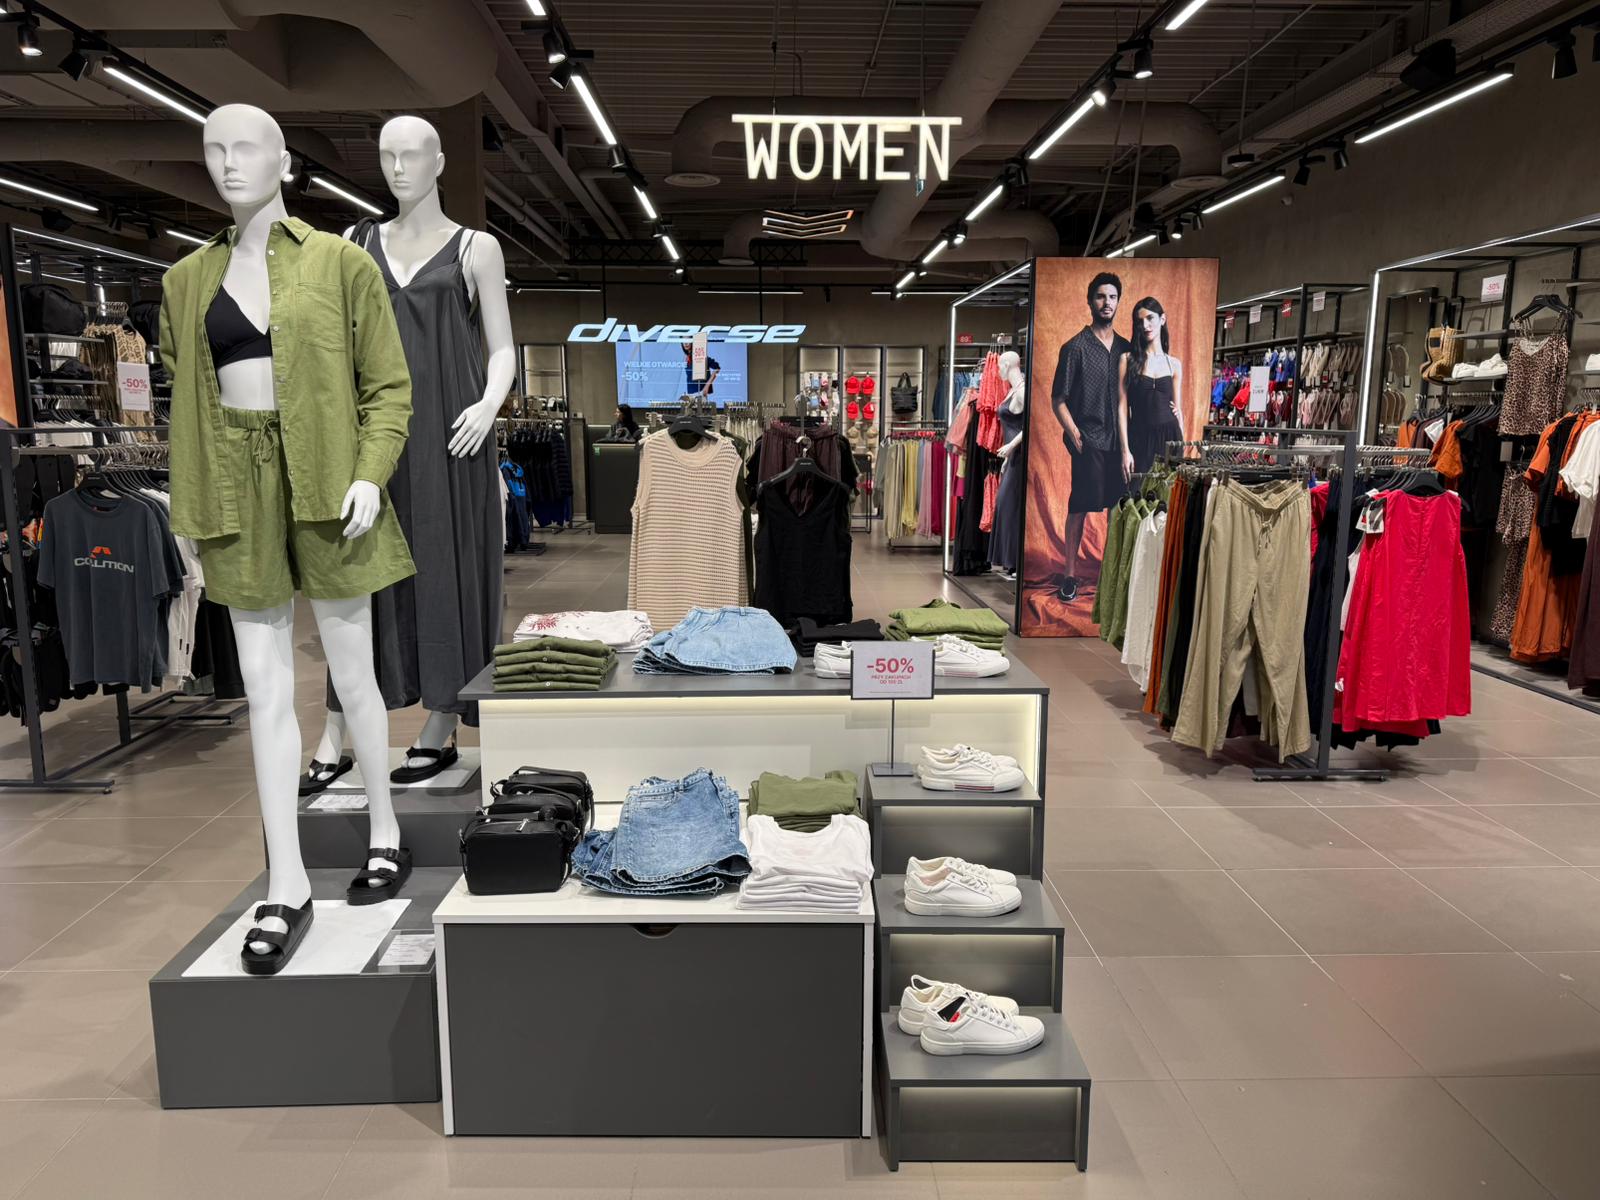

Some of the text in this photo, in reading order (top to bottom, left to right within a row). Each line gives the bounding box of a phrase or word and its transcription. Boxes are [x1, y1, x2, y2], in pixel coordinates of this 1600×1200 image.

[737, 114, 955, 181] WOMEN
[567, 317, 807, 343] diverse
[122, 378, 148, 389] -50%
[621, 371, 649, 381] -50%
[867, 657, 914, 673] -50%
